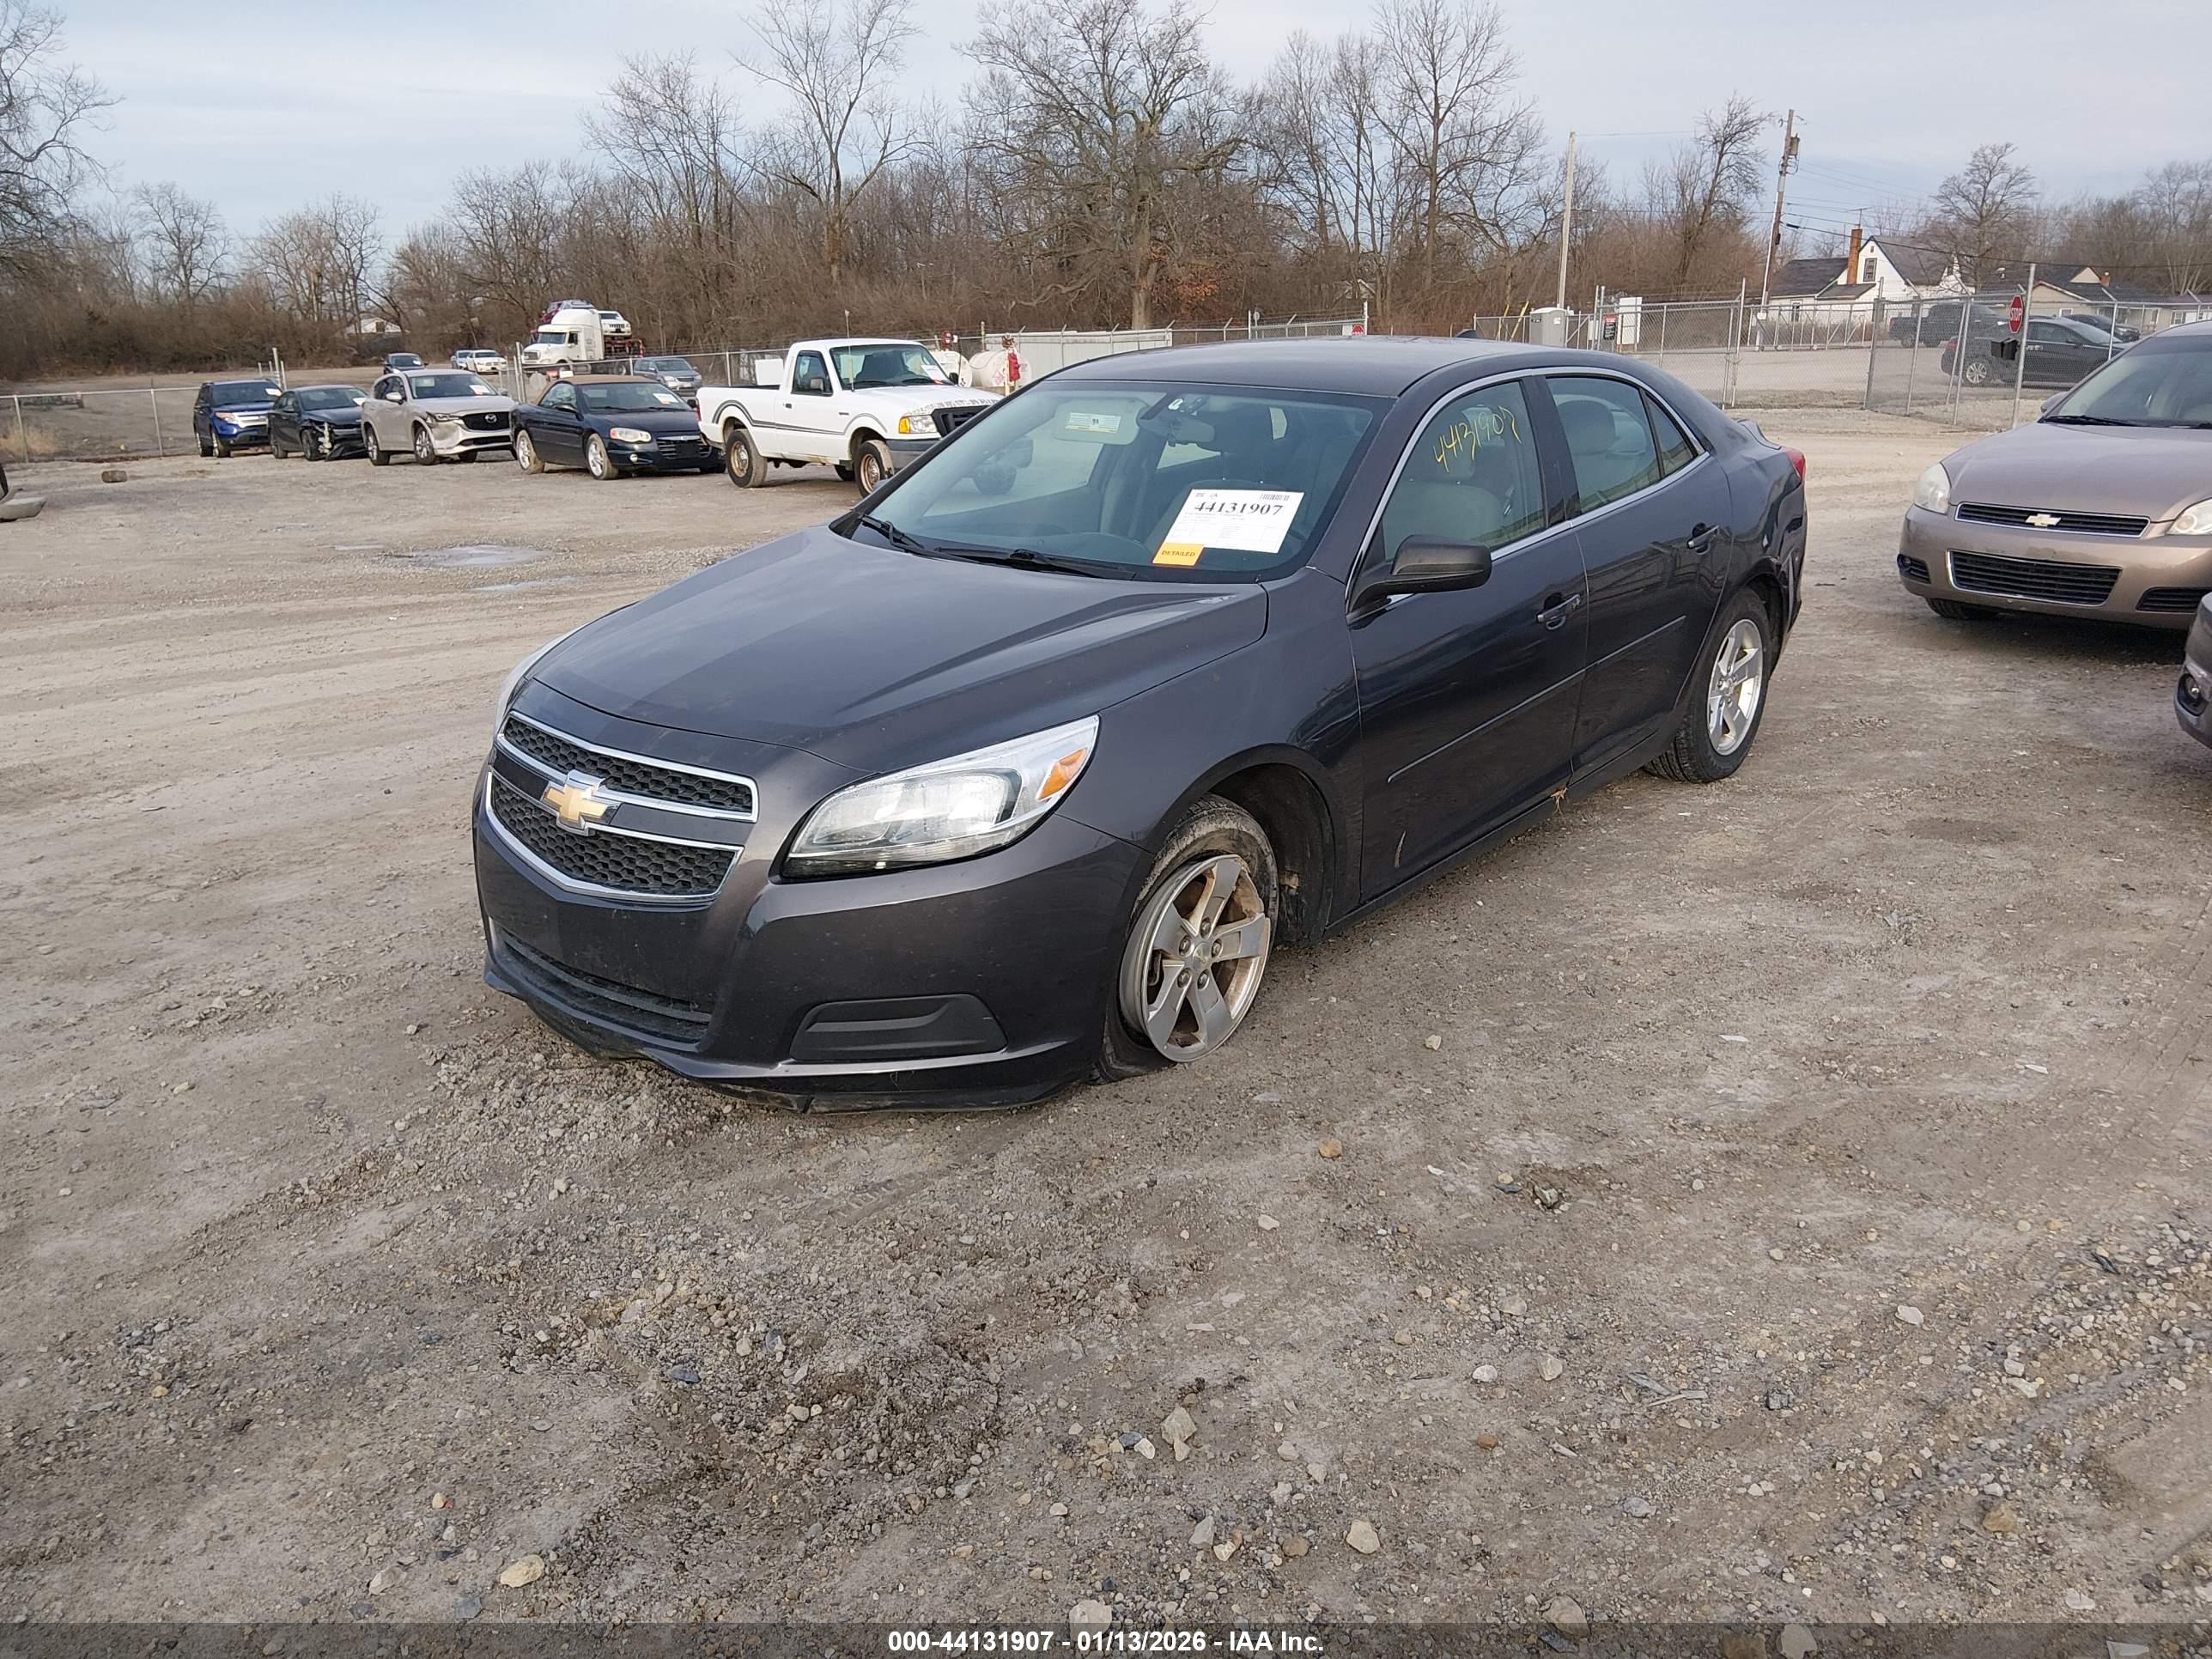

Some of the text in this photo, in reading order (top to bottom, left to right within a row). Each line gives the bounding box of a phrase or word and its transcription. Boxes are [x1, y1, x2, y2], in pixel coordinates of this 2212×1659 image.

[2010, 307, 2023, 321] STOP
[1433, 405, 1522, 472] 44131907
[1194, 501, 1284, 515] 44131907
